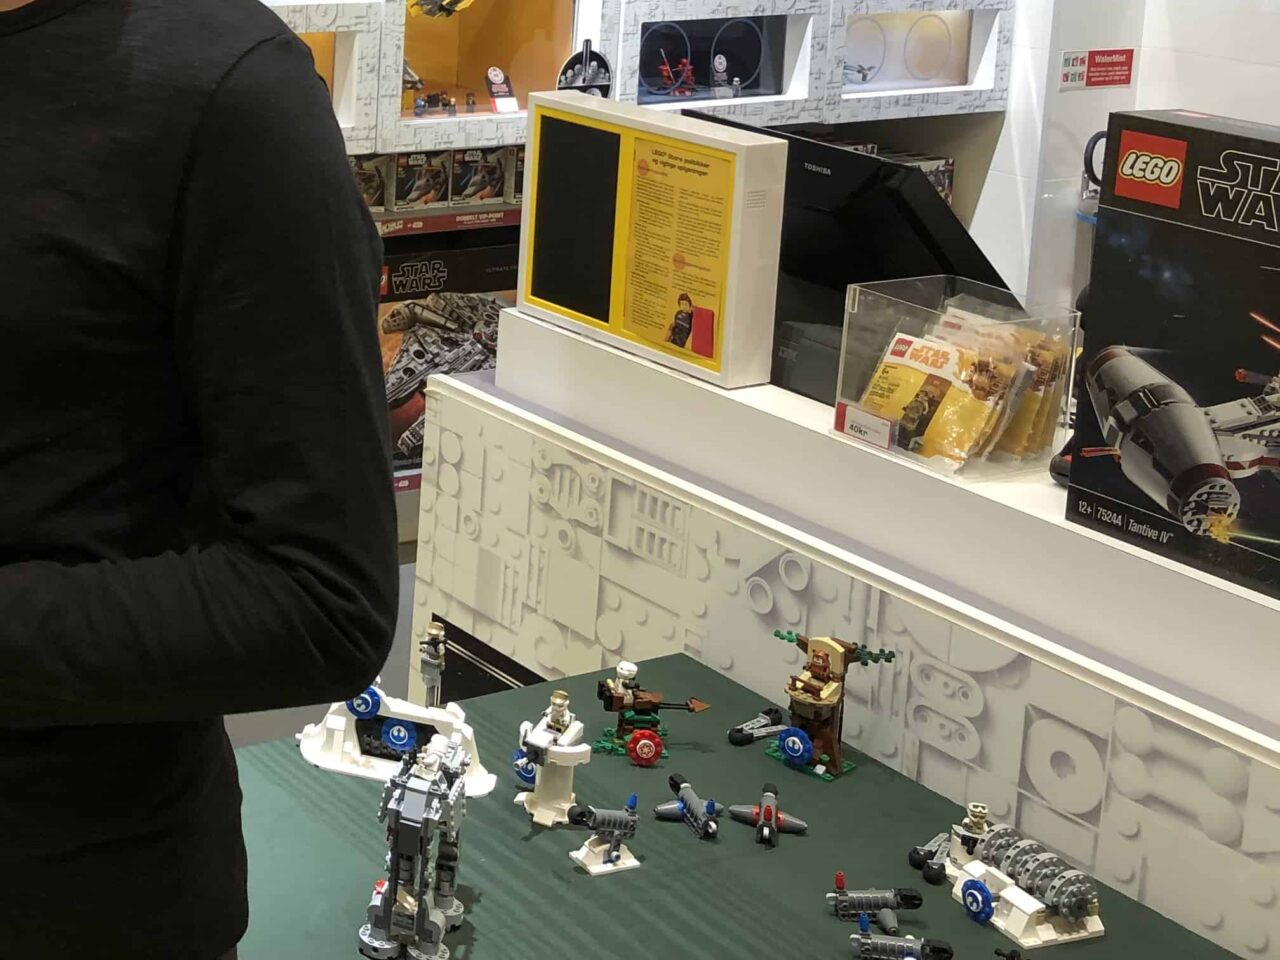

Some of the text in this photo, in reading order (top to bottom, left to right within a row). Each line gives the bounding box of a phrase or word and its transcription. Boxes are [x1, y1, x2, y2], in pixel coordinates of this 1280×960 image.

[804, 162, 831, 175] TOSHIBA
[1120, 150, 1182, 186] LEGO
[1197, 150, 1280, 195] ST
[1197, 179, 1280, 233] WA
[392, 260, 447, 279] STAR
[392, 273, 447, 294] WARS
[894, 342, 910, 354] LEGO
[911, 345, 950, 360] STAR
[909, 354, 950, 369] WARS
[1078, 500, 1092, 514] 12+
[1097, 506, 1122, 526] 75244
[1128, 518, 1158, 541] Tantive
